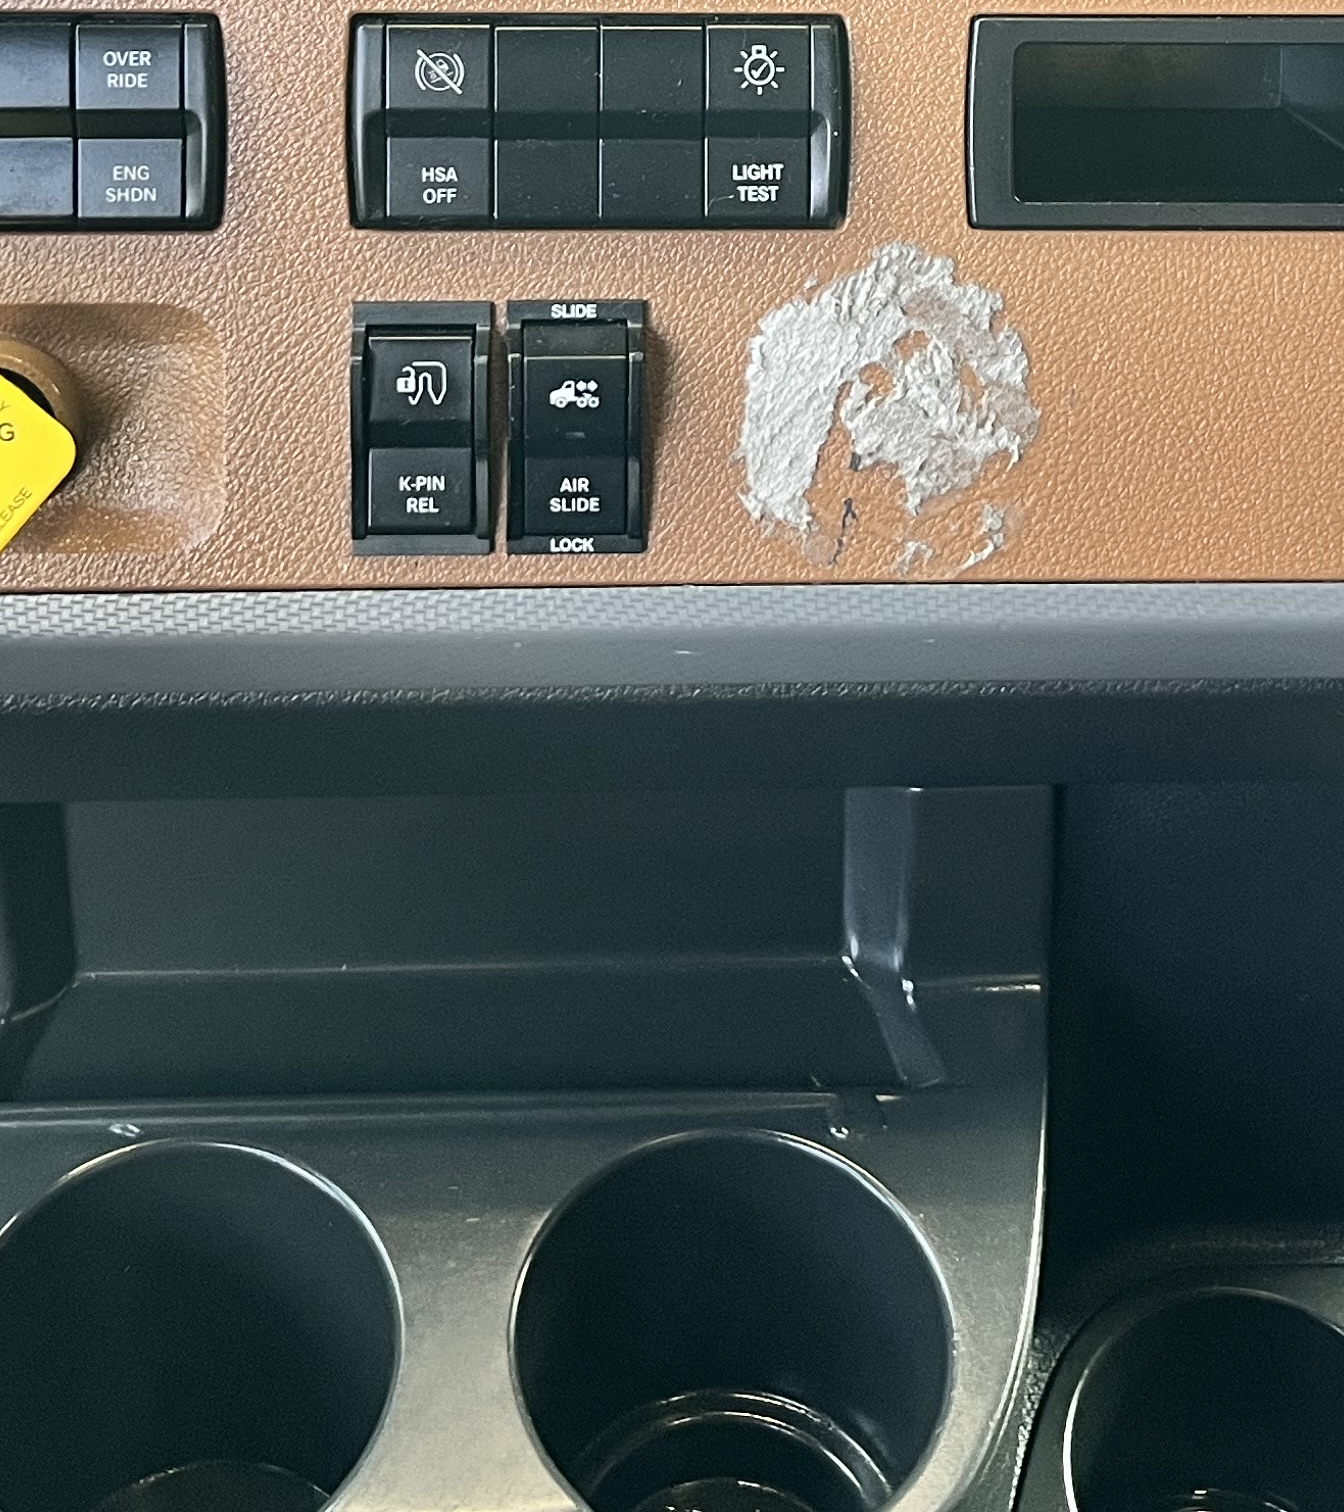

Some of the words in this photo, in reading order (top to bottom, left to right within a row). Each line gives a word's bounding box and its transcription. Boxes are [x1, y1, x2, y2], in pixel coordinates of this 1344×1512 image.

[102, 49, 153, 68] OVER
[106, 71, 149, 90] RIDE
[112, 164, 151, 183] ENG
[421, 166, 459, 184] HSA
[732, 163, 784, 182] LIGHT
[104, 185, 157, 204] SHDN
[422, 187, 458, 205] OFF
[736, 185, 780, 204] TEST
[550, 302, 598, 320] SLIDE
[398, 475, 446, 493] K-PIN
[559, 476, 590, 494] AIR
[405, 496, 440, 515] REL
[548, 497, 601, 514] SLIDE
[549, 537, 595, 554] LOCK
